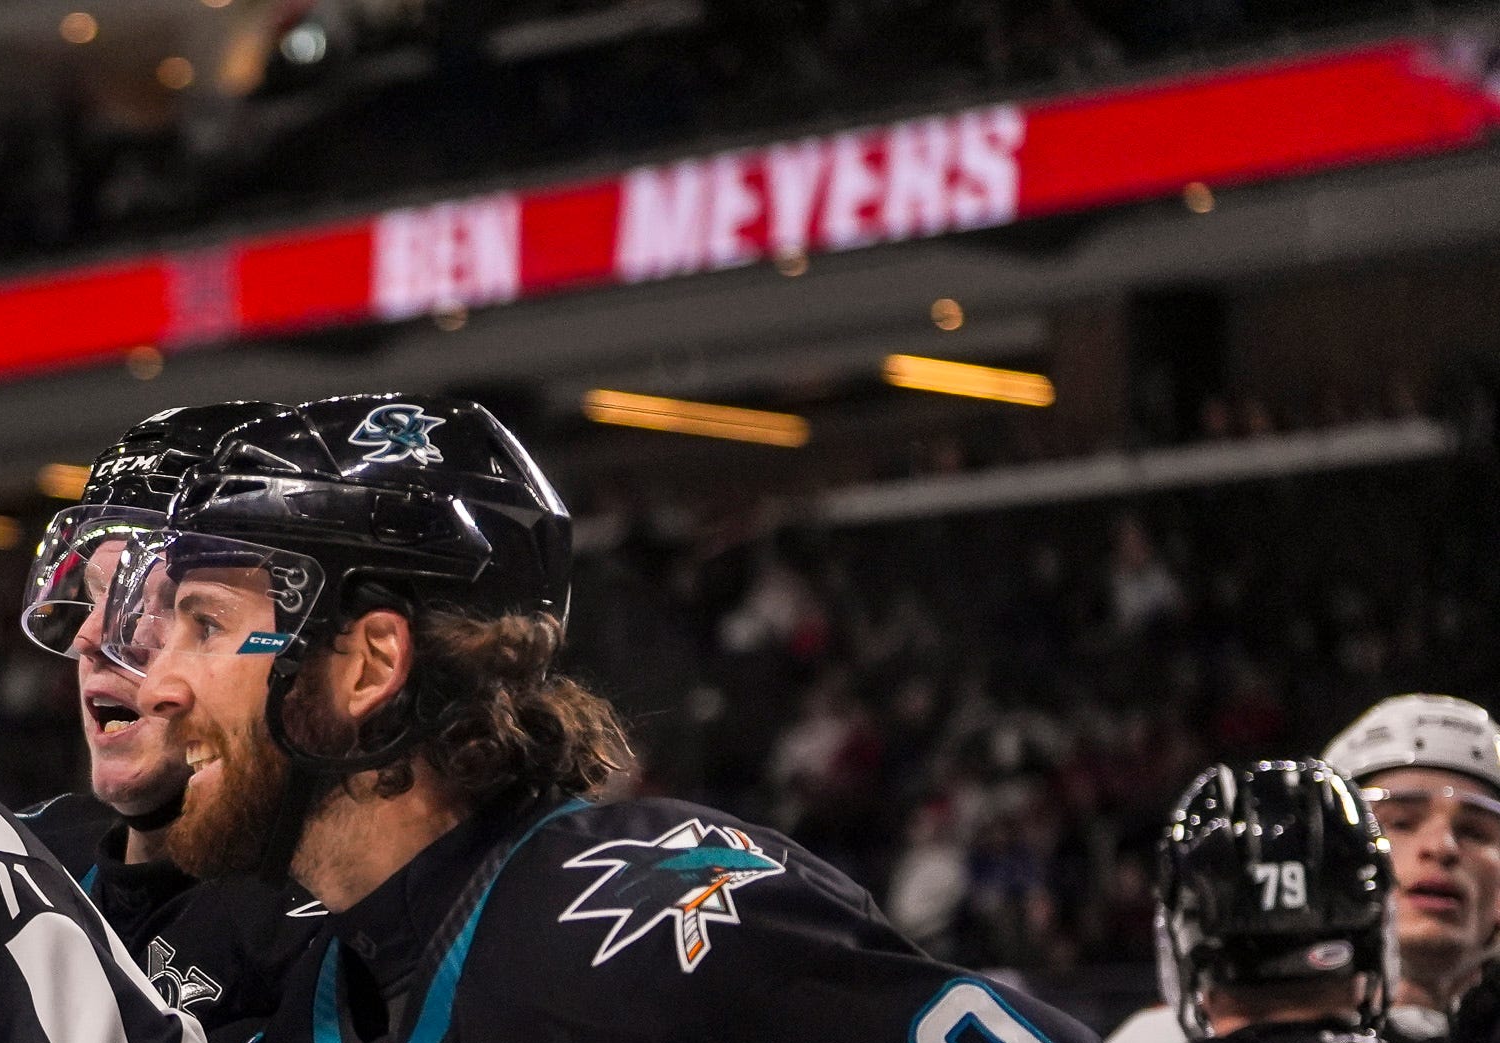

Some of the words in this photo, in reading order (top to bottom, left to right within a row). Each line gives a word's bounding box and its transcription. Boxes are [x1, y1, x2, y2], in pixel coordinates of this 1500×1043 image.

[372, 196, 522, 321] BEN
[615, 104, 1026, 285] MEYERS
[95, 455, 159, 477] CCM
[249, 636, 284, 647] CCM
[1252, 861, 1308, 911] 79
